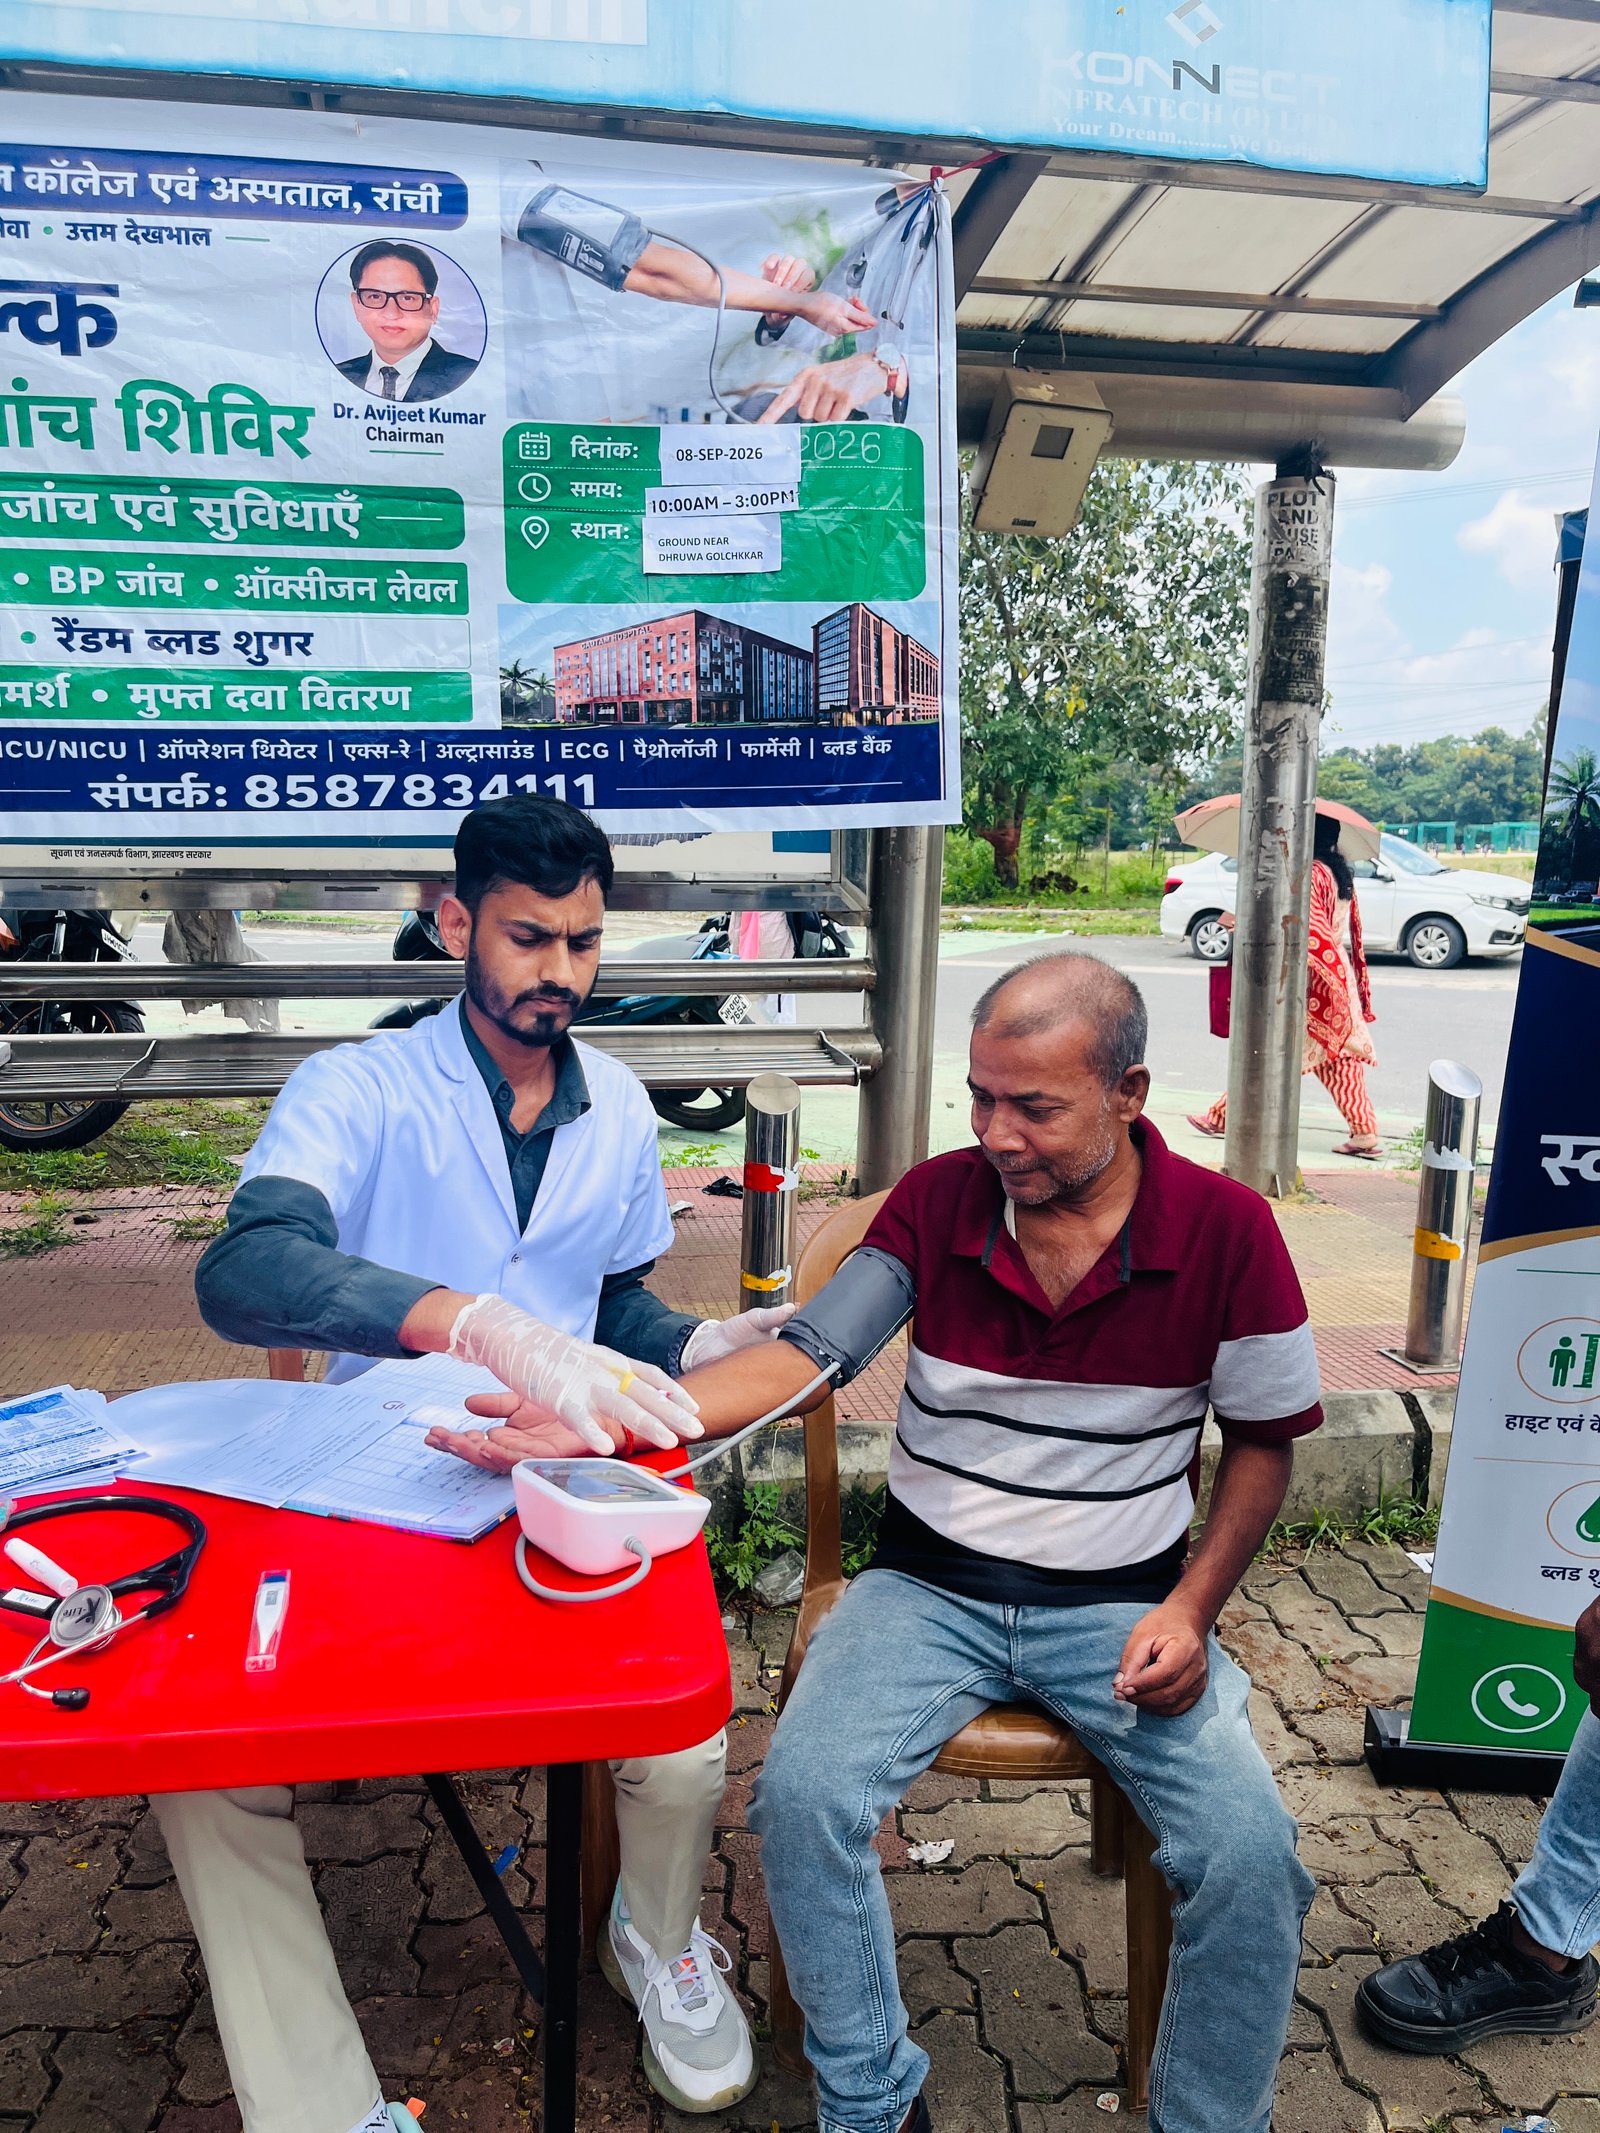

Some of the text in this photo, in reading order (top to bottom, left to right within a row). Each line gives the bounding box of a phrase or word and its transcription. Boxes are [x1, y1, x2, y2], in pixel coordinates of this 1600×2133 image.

[1046, 86, 1223, 124] NFRATECH
[1053, 117, 1102, 136] Your
[23, 159, 137, 197] कॉलेज
[148, 167, 199, 206] एवं
[209, 176, 363, 215] अस्पताल,
[370, 180, 443, 214] रांची
[65, 221, 117, 243] उत्तम
[125, 218, 213, 247] देखभाल
[115, 378, 316, 460] शिविर
[333, 402, 487, 426] Dr. Avijeet Kumar
[365, 425, 445, 445] Chairman
[570, 436, 639, 460] दिनांक:
[676, 447, 763, 462] 08-SEP-2026
[570, 482, 623, 498] समय:
[652, 496, 719, 513] 10:00AM
[735, 490, 795, 508] 3:00PM
[1268, 490, 1319, 508] PLOT
[0, 481, 364, 542] जांच एवं सुविधाएँ
[570, 522, 629, 541] स्थान:
[658, 537, 729, 547] GROUND NEAR
[659, 551, 763, 561] DHRUWA GOLCHKKAR
[49, 562, 458, 604] BP जांच ऑक्सीजन लेवल
[52, 616, 314, 666] रैंडम ब्लड शुगर
[127, 683, 213, 719] मुफ्त
[223, 684, 288, 712] दवा
[298, 681, 412, 712] वितरण
[157, 738, 245, 761] ऑपरेशन
[250, 739, 318, 761] थियेटर
[343, 741, 411, 763] एक्स-रे
[435, 738, 535, 762] अल्ट्रासाउंड
[560, 743, 609, 760] ECG
[633, 737, 718, 761] पैथोलॉजी
[740, 736, 801, 759] फार्मेसी
[822, 739, 858, 758] ब्लड
[861, 736, 893, 756] बैंक
[88, 772, 595, 810] संपर्क: 8587834111
[50, 849, 73, 860] सूचना
[74, 848, 85, 858] एवं
[185, 850, 212, 859] सरकार
[1505, 1414, 1551, 1434] हाइट
[1556, 1413, 1585, 1433] एवं
[1541, 1565, 1583, 1581] ब्लड
